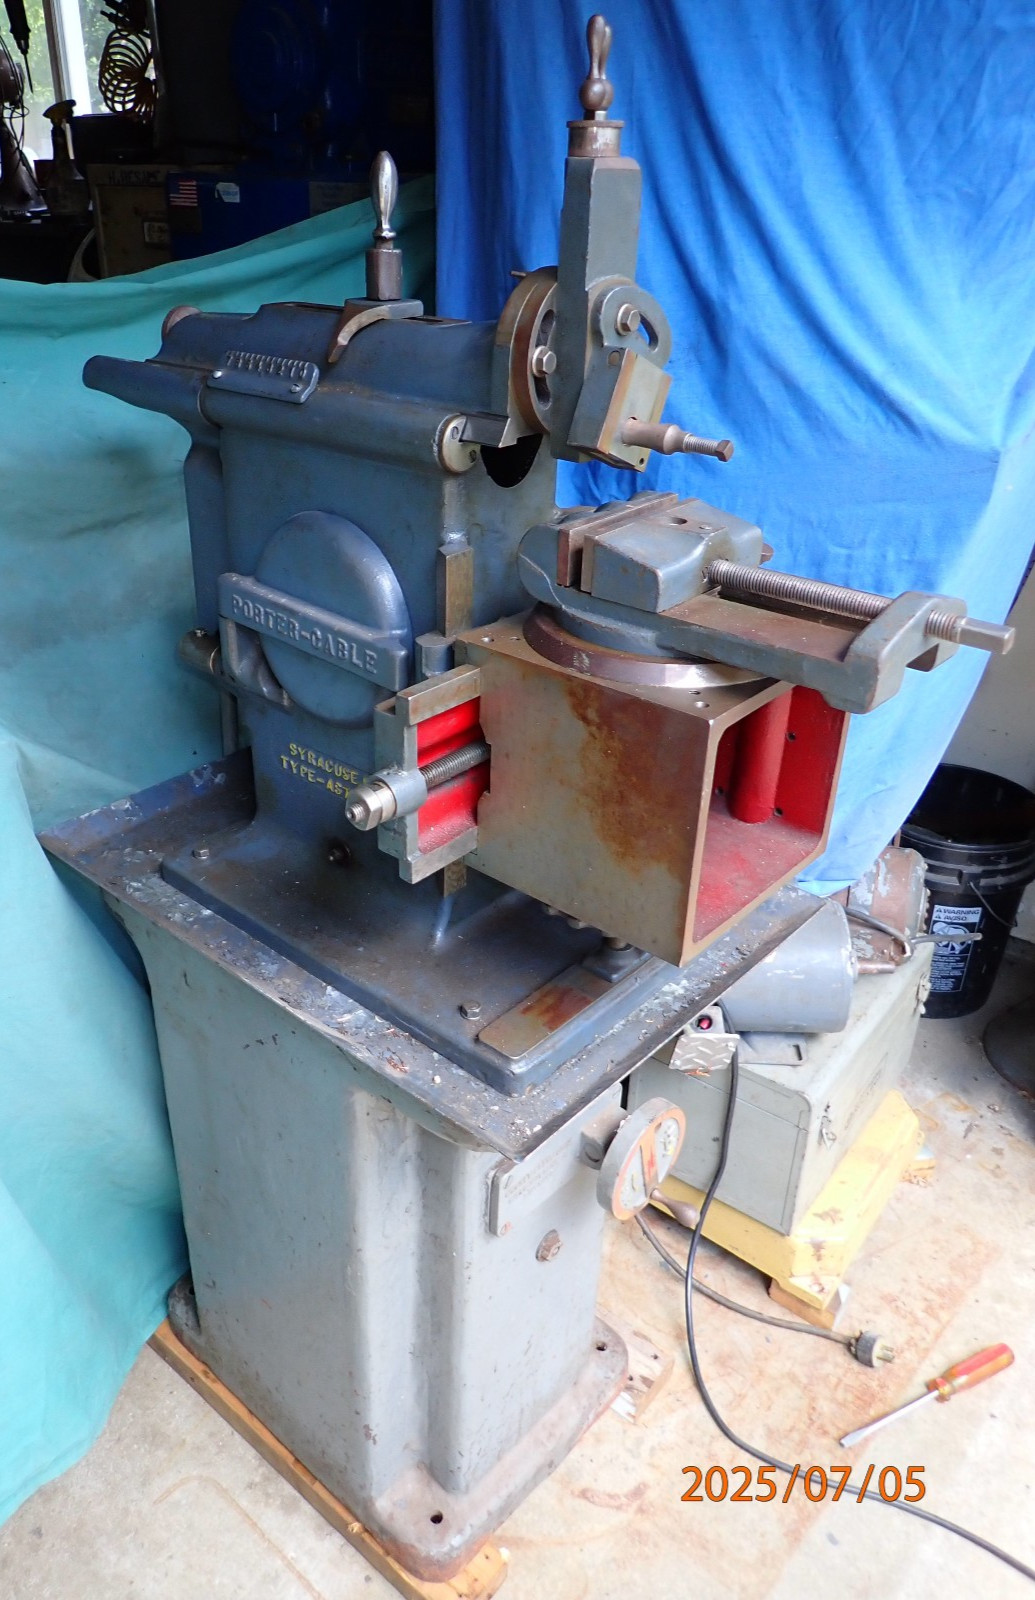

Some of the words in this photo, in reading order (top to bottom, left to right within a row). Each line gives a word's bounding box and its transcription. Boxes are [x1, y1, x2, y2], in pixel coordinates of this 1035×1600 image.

[232, 594, 378, 674] PORTER-CABLE
[289, 743, 358, 785] SYRACUSE
[943, 908, 980, 916] WARNING
